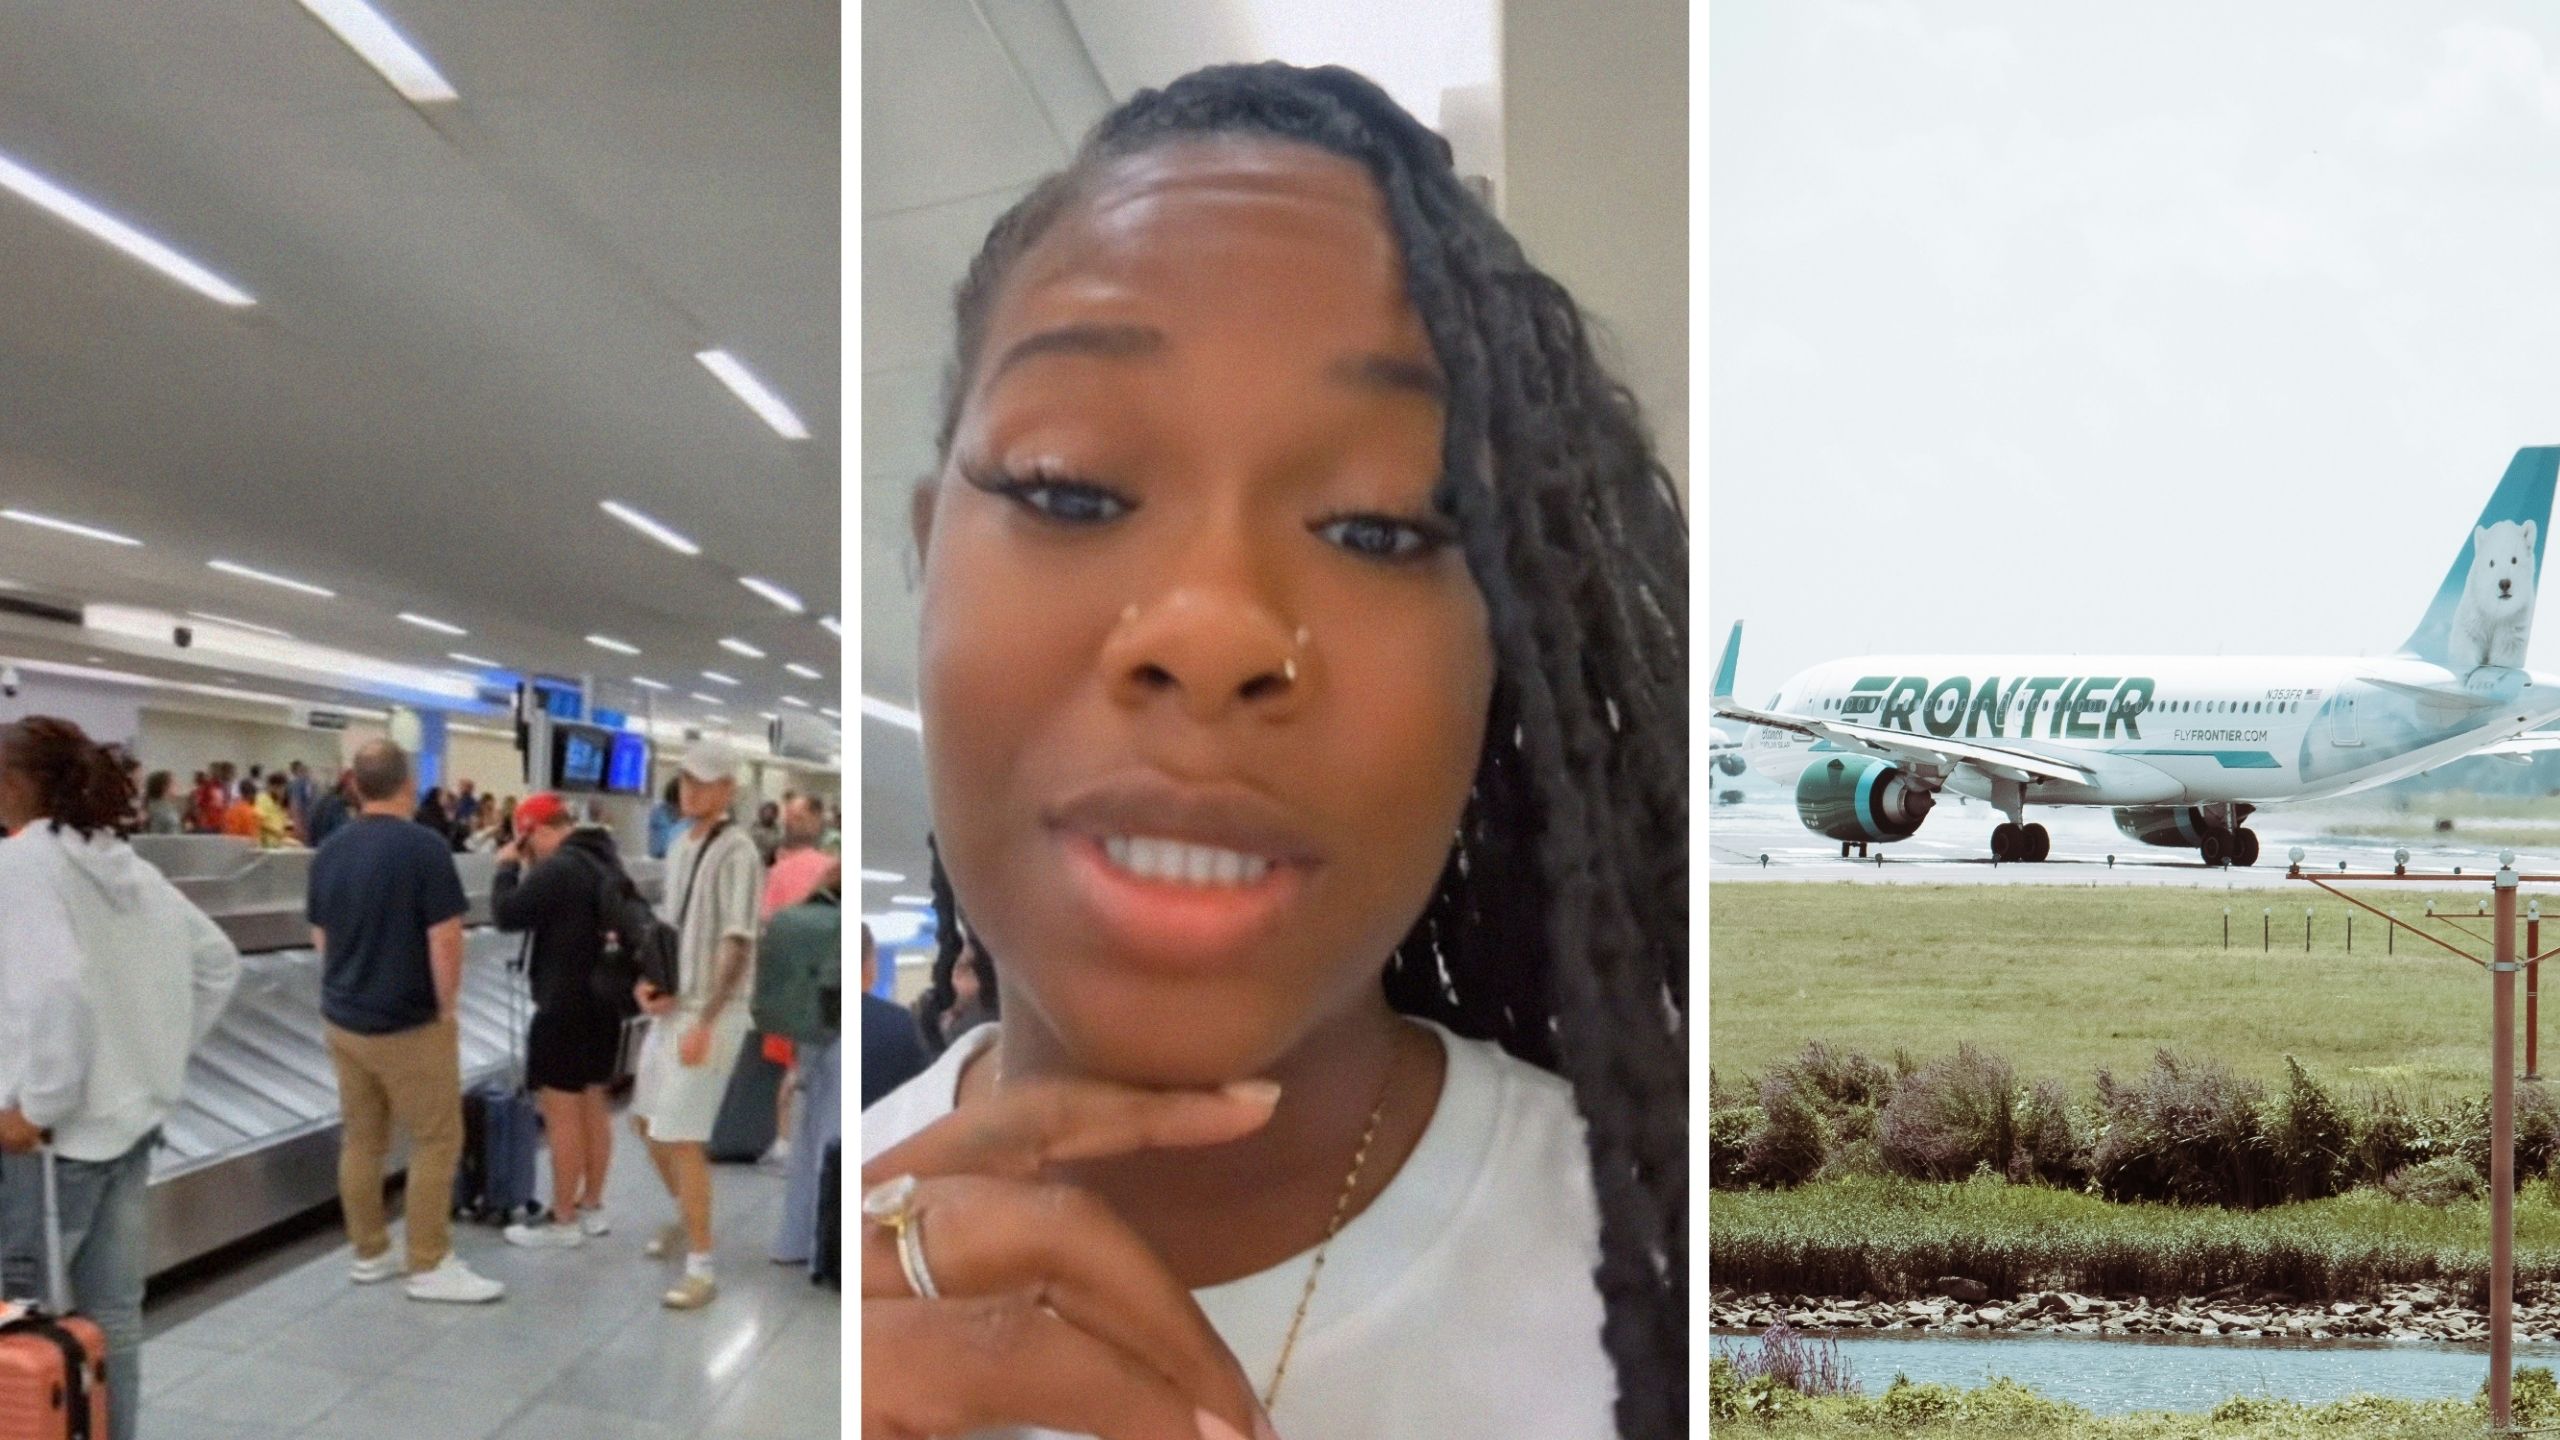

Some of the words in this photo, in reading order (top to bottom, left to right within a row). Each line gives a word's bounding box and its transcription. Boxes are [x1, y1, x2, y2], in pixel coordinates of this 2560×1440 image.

[2265, 689, 2303, 700] N353FR
[1841, 676, 2155, 739] FRONTIER
[2174, 729, 2267, 742] FLYFRONTIER.COM
